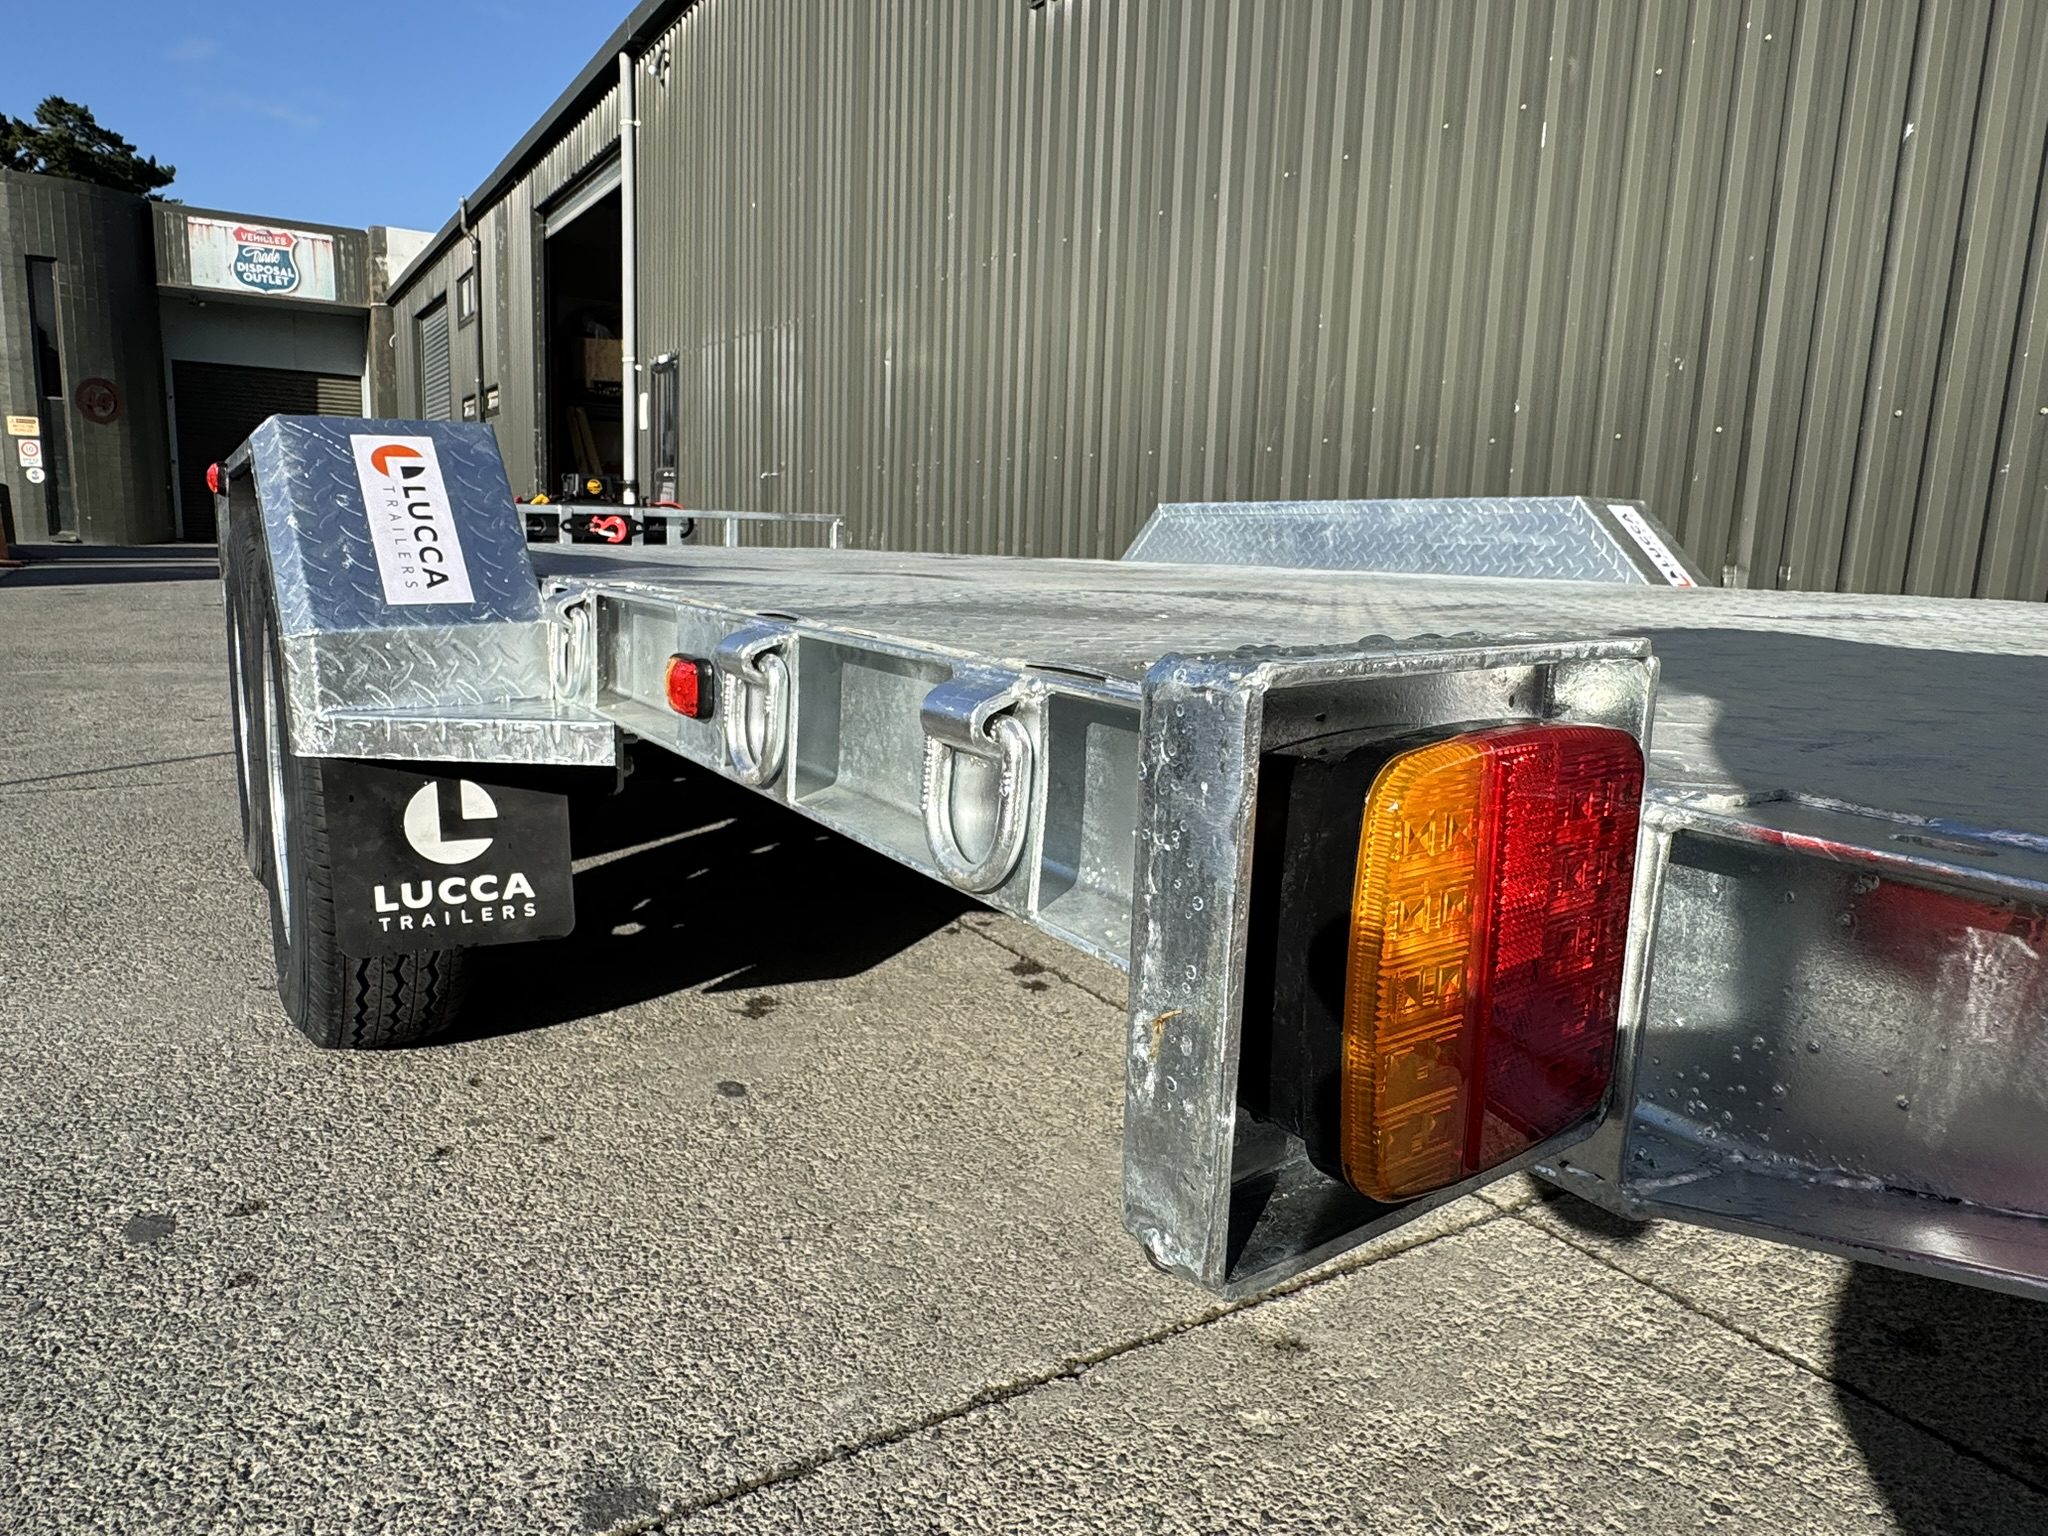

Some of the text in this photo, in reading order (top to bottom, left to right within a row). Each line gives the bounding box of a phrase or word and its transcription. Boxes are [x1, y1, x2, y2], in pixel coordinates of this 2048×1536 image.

[236, 262, 295, 278] DISPOSAL
[242, 247, 281, 264] Trade
[243, 271, 290, 286] OUTLET
[383, 486, 418, 589] TRAILERS
[402, 486, 449, 589] LUCCA
[374, 872, 536, 913] LUCCA
[378, 902, 537, 932] TRAILERS
